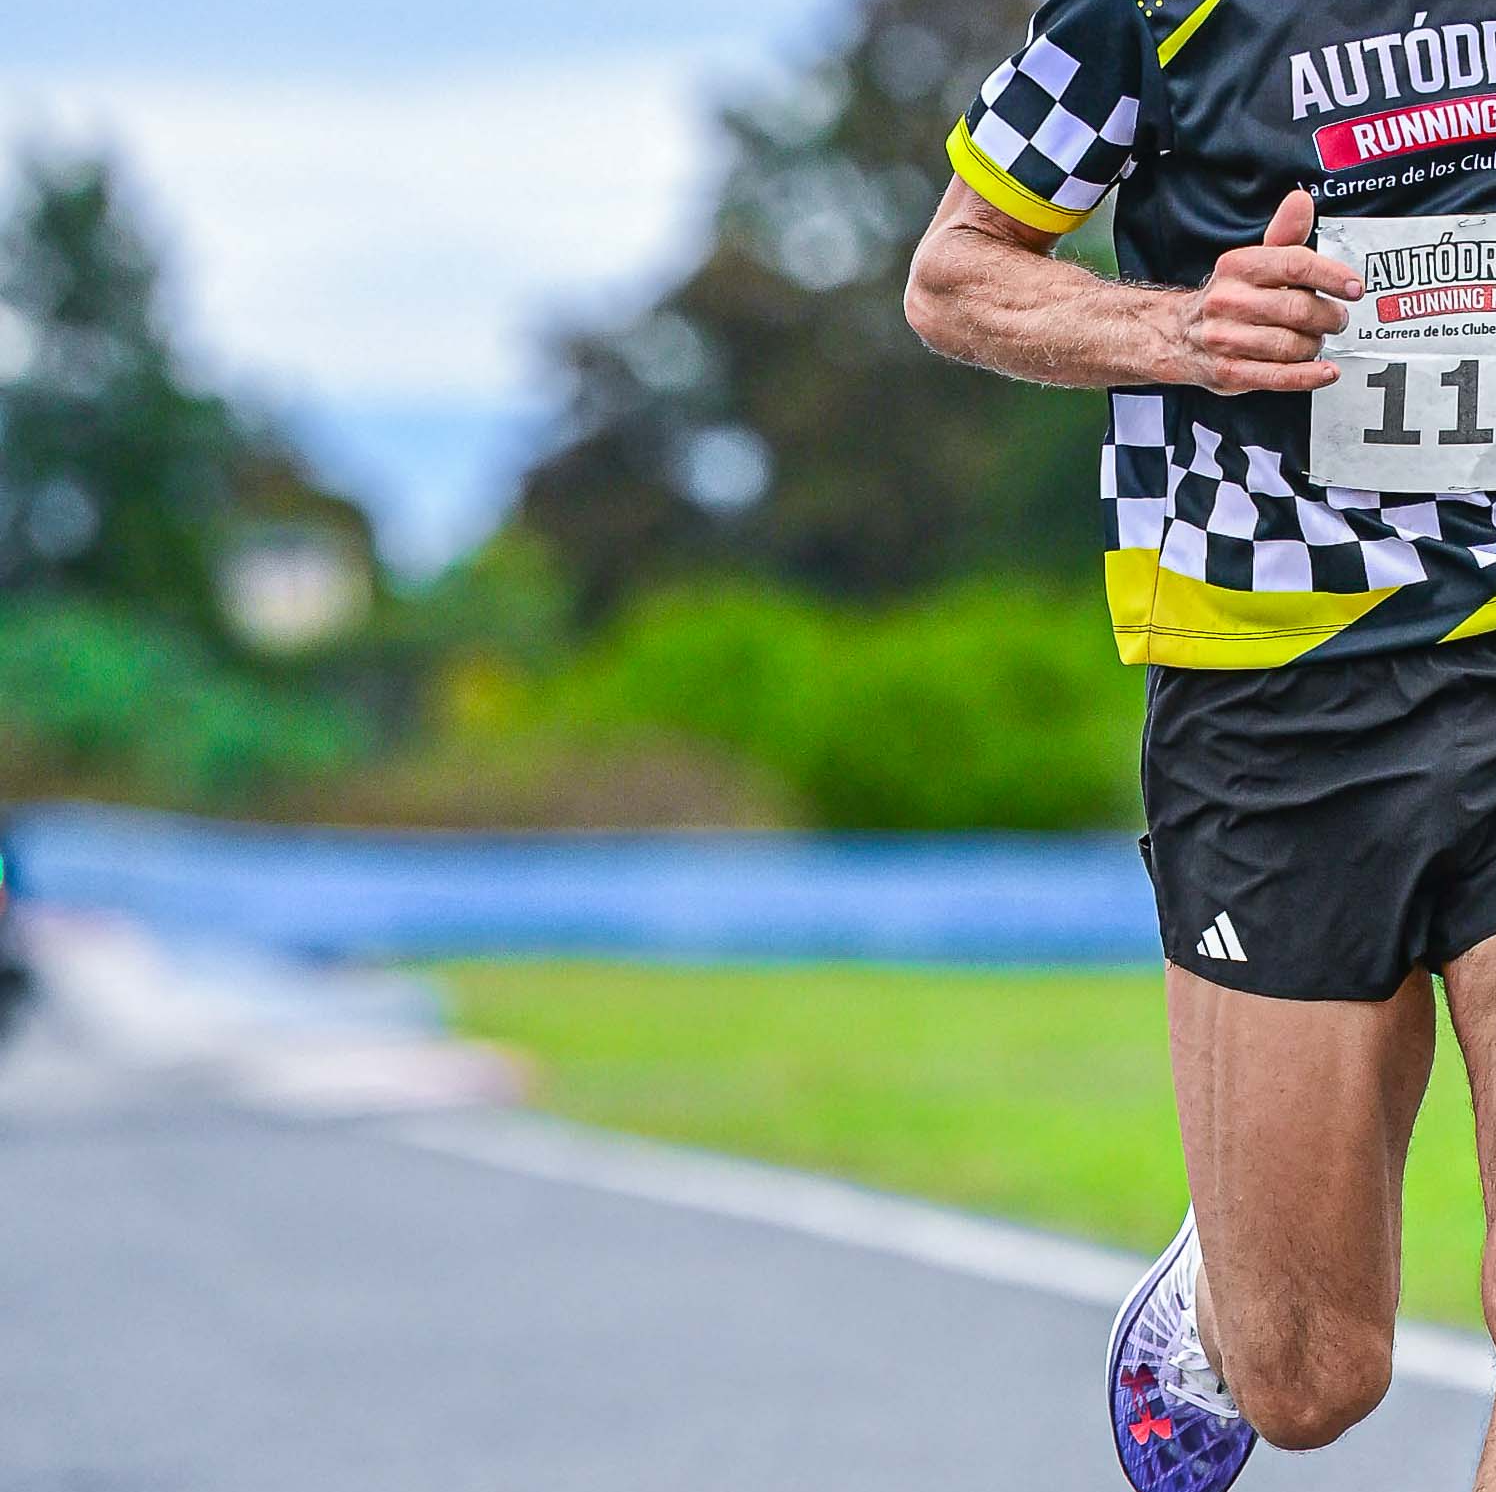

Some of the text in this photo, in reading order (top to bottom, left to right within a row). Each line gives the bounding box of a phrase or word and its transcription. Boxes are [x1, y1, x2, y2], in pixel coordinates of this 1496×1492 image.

[1323, 172, 1396, 198] Carrera
[1401, 165, 1425, 185] de
[1429, 160, 1456, 179] los
[1398, 288, 1486, 318] RUNNING
[1358, 327, 1372, 340] La
[1375, 325, 1420, 339] Carrera
[1423, 324, 1439, 338] de
[1441, 322, 1459, 337] los
